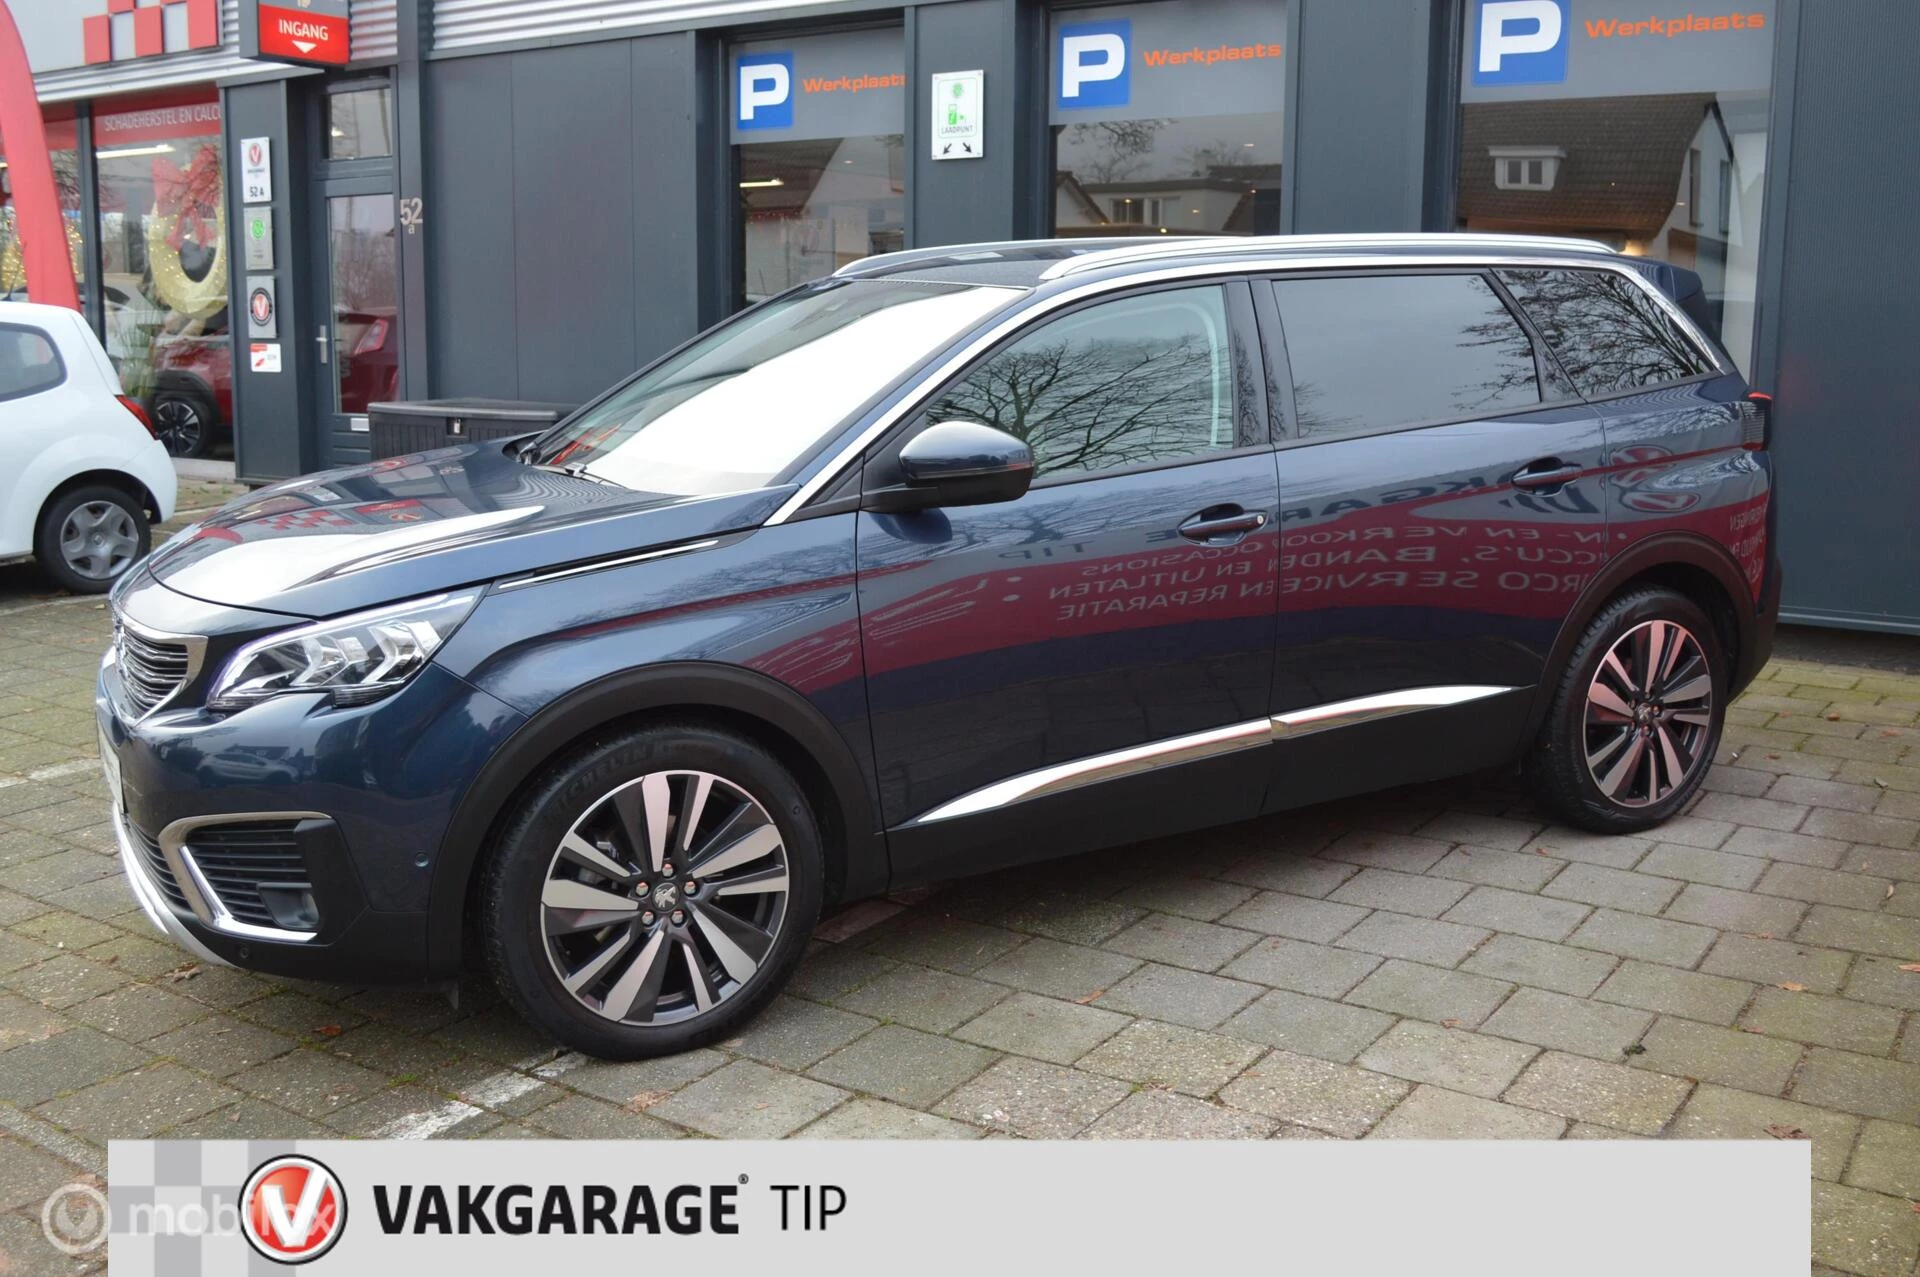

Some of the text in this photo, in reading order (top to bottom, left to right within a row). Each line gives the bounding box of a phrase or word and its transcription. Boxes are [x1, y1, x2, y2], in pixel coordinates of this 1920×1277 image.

[279, 19, 329, 41] INGANG
[1478, 0, 1562, 72] P
[1585, 12, 1766, 39] Werkplaats
[1062, 33, 1125, 98] P
[1143, 43, 1281, 68] Werkplaats
[740, 63, 790, 121] P
[103, 110, 178, 132] SCHADEHERSTEL
[180, 108, 193, 124] EN
[941, 125, 973, 134] LAADPUNT
[250, 186, 258, 197] 52
[400, 197, 424, 226] 52
